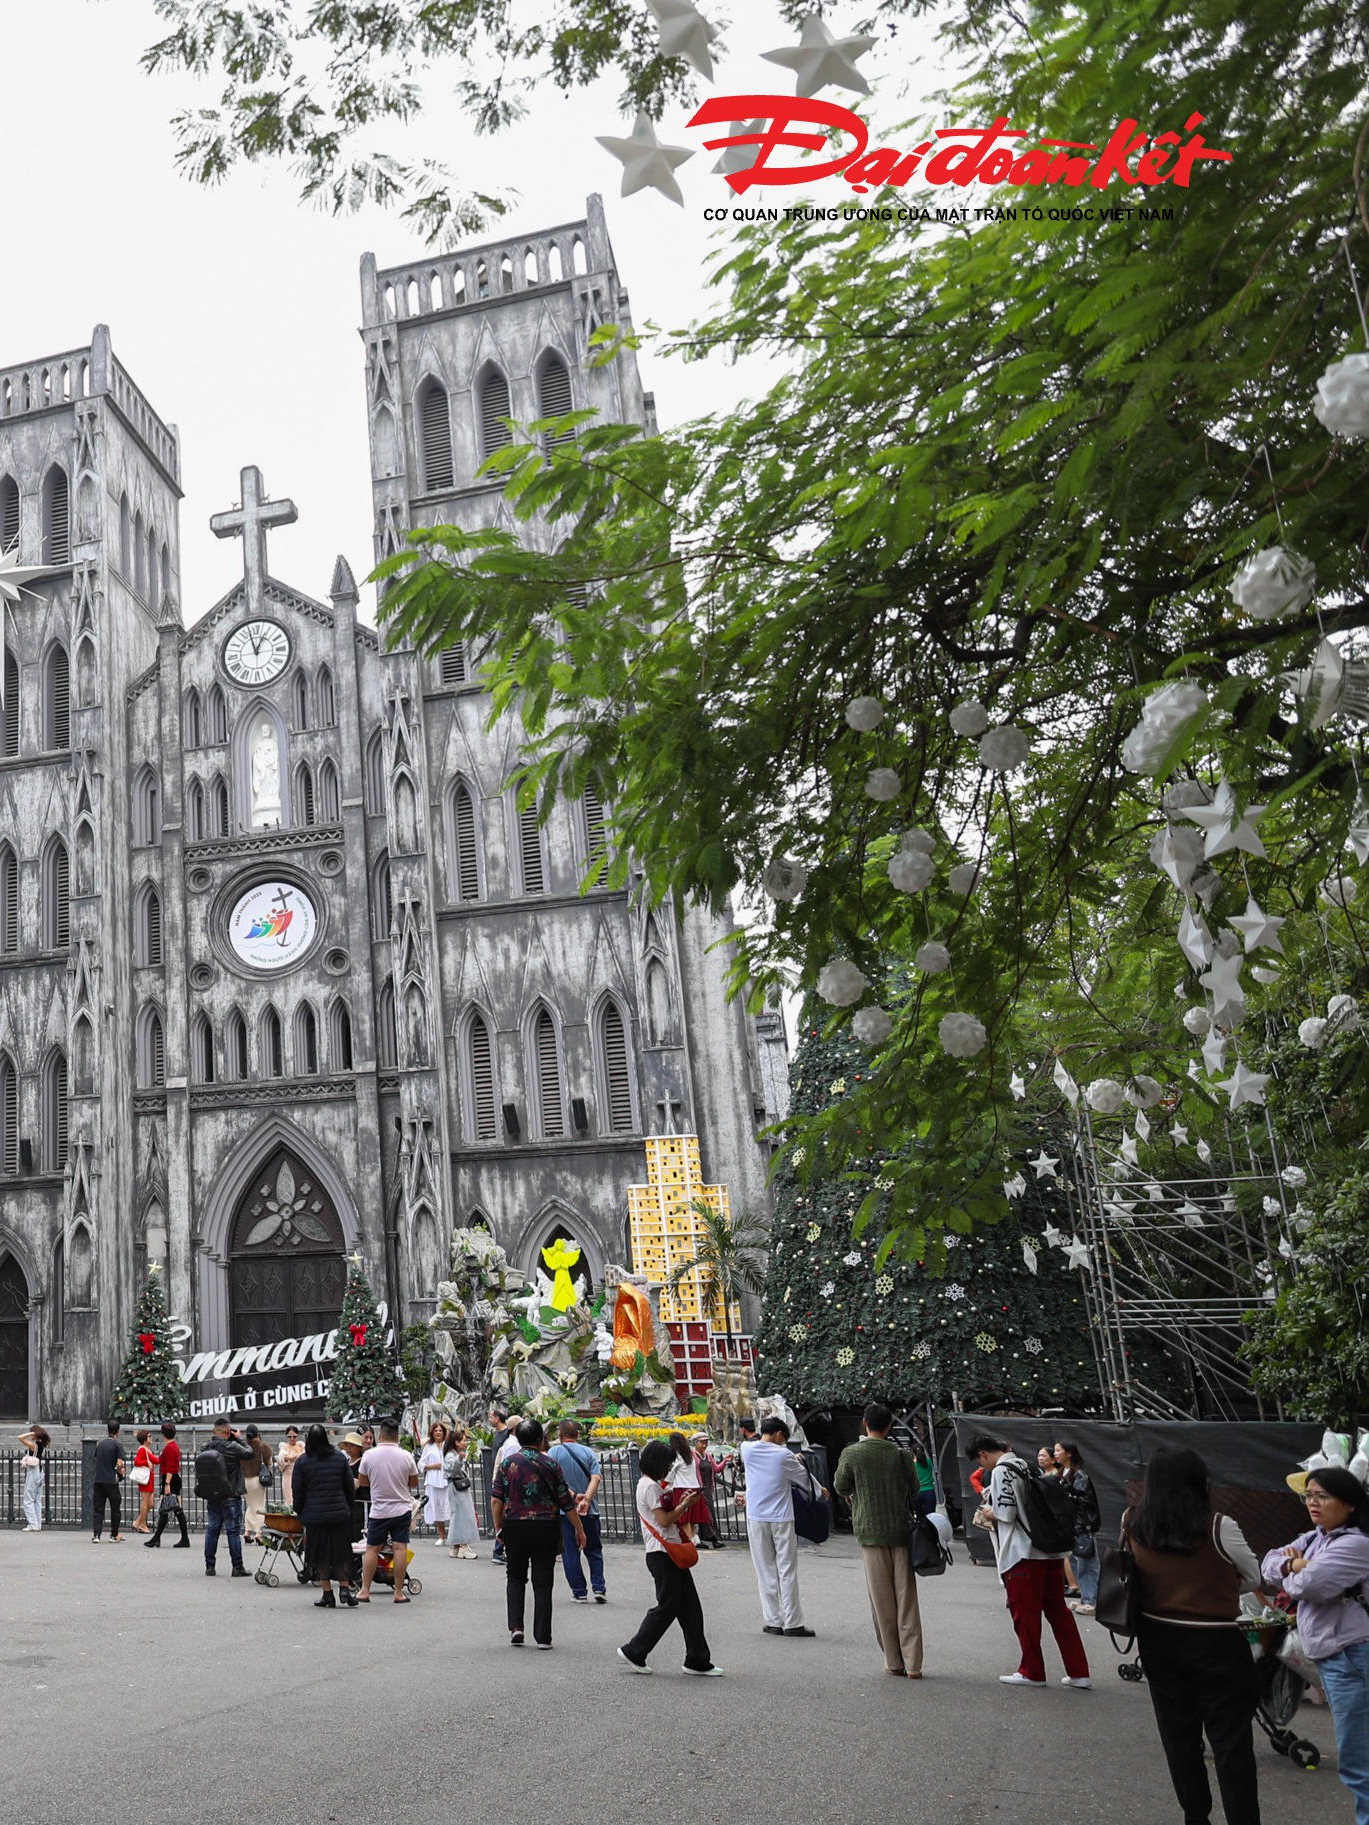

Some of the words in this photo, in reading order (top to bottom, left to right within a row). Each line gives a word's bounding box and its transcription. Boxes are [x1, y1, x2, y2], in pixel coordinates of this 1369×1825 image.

[190, 1393, 239, 1418] CHÚA
[244, 1386, 258, 1410] Ở
[263, 1382, 312, 1407] CÙNG
